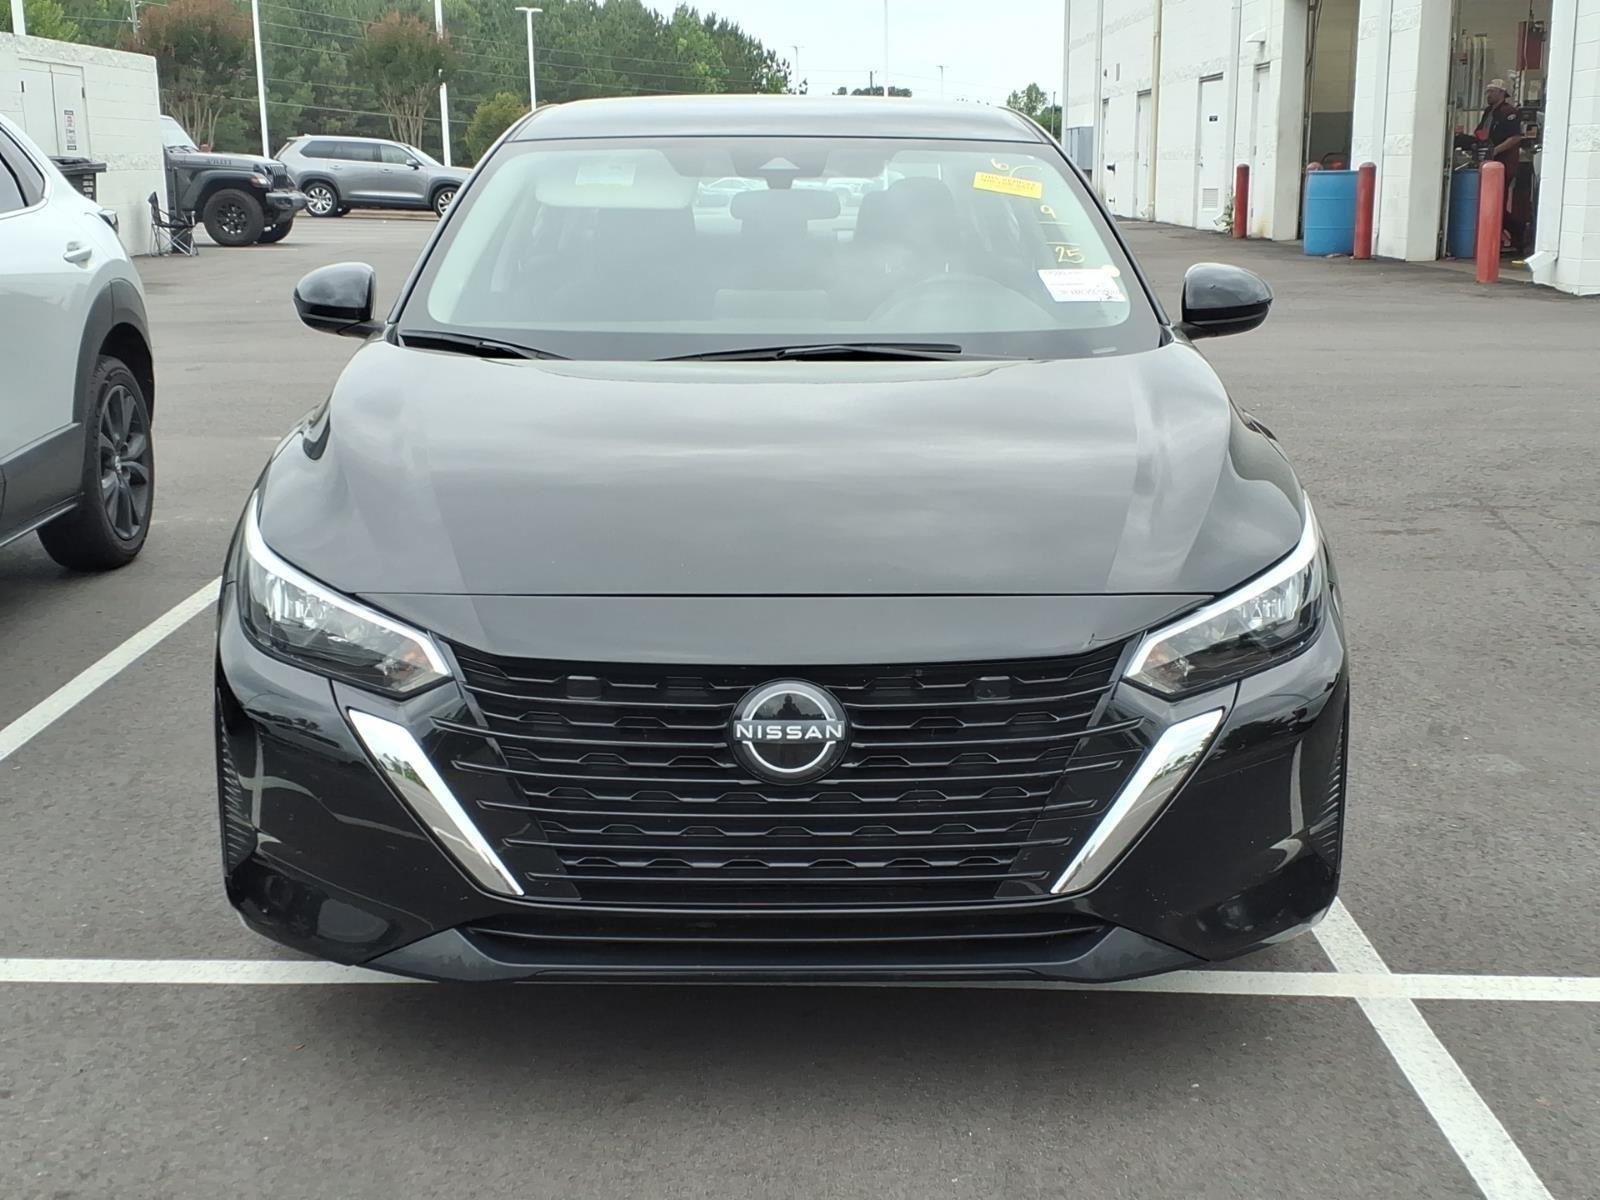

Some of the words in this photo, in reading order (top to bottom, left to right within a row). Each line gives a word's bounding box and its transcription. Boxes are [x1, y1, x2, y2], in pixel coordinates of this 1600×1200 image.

[1040, 204, 1056, 219] 9
[1056, 246, 1085, 263] 25
[736, 724, 842, 739] NISSAN
